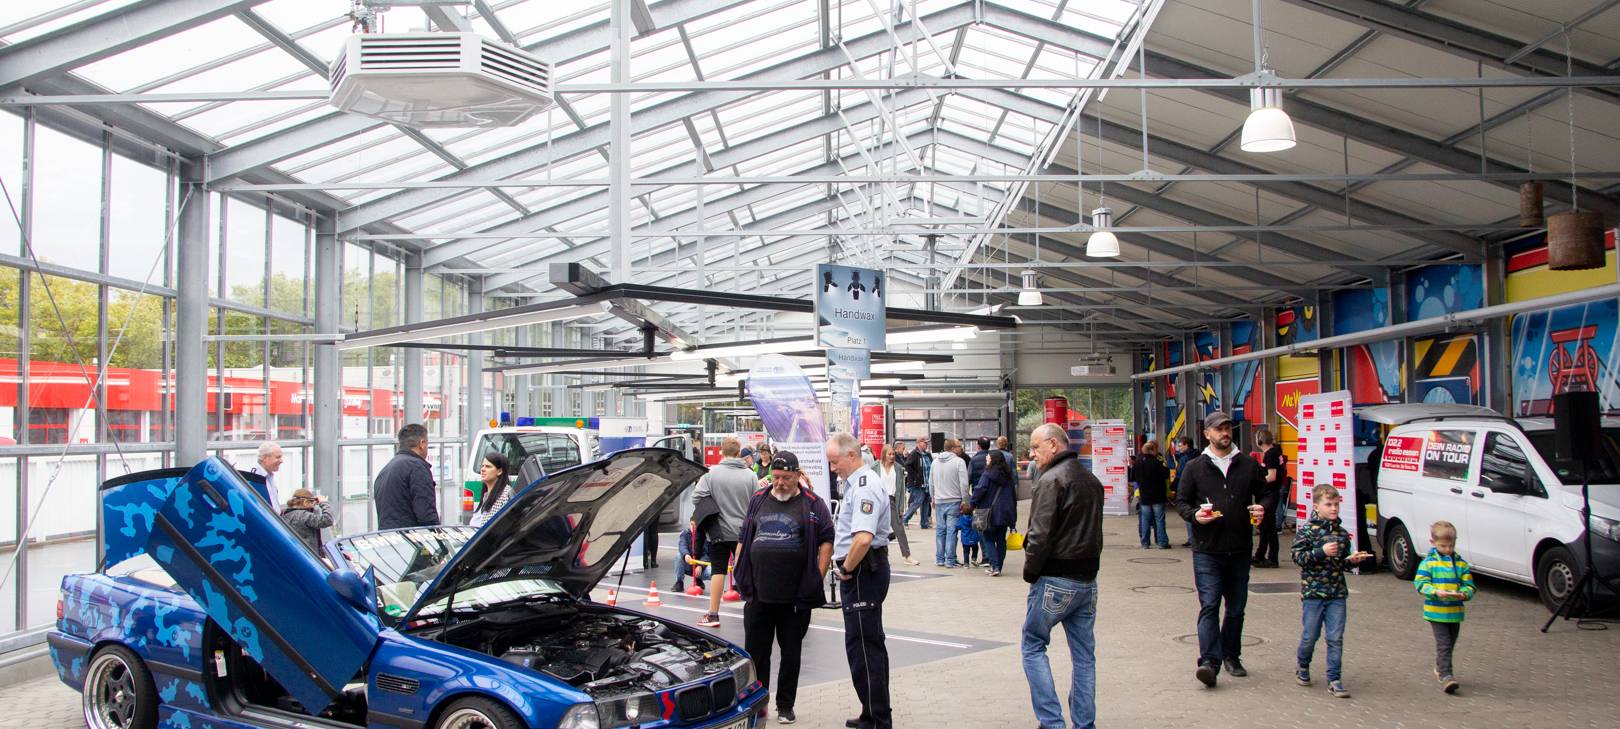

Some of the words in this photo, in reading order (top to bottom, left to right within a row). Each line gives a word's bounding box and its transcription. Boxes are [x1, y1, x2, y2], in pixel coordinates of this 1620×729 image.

[834, 307, 875, 320] Handwax
[847, 336, 862, 344] Platz
[1427, 442, 1444, 451] DEIN
[1445, 443, 1471, 453] RADIO
[1425, 450, 1440, 461] ON
[1442, 451, 1469, 464] TOUR
